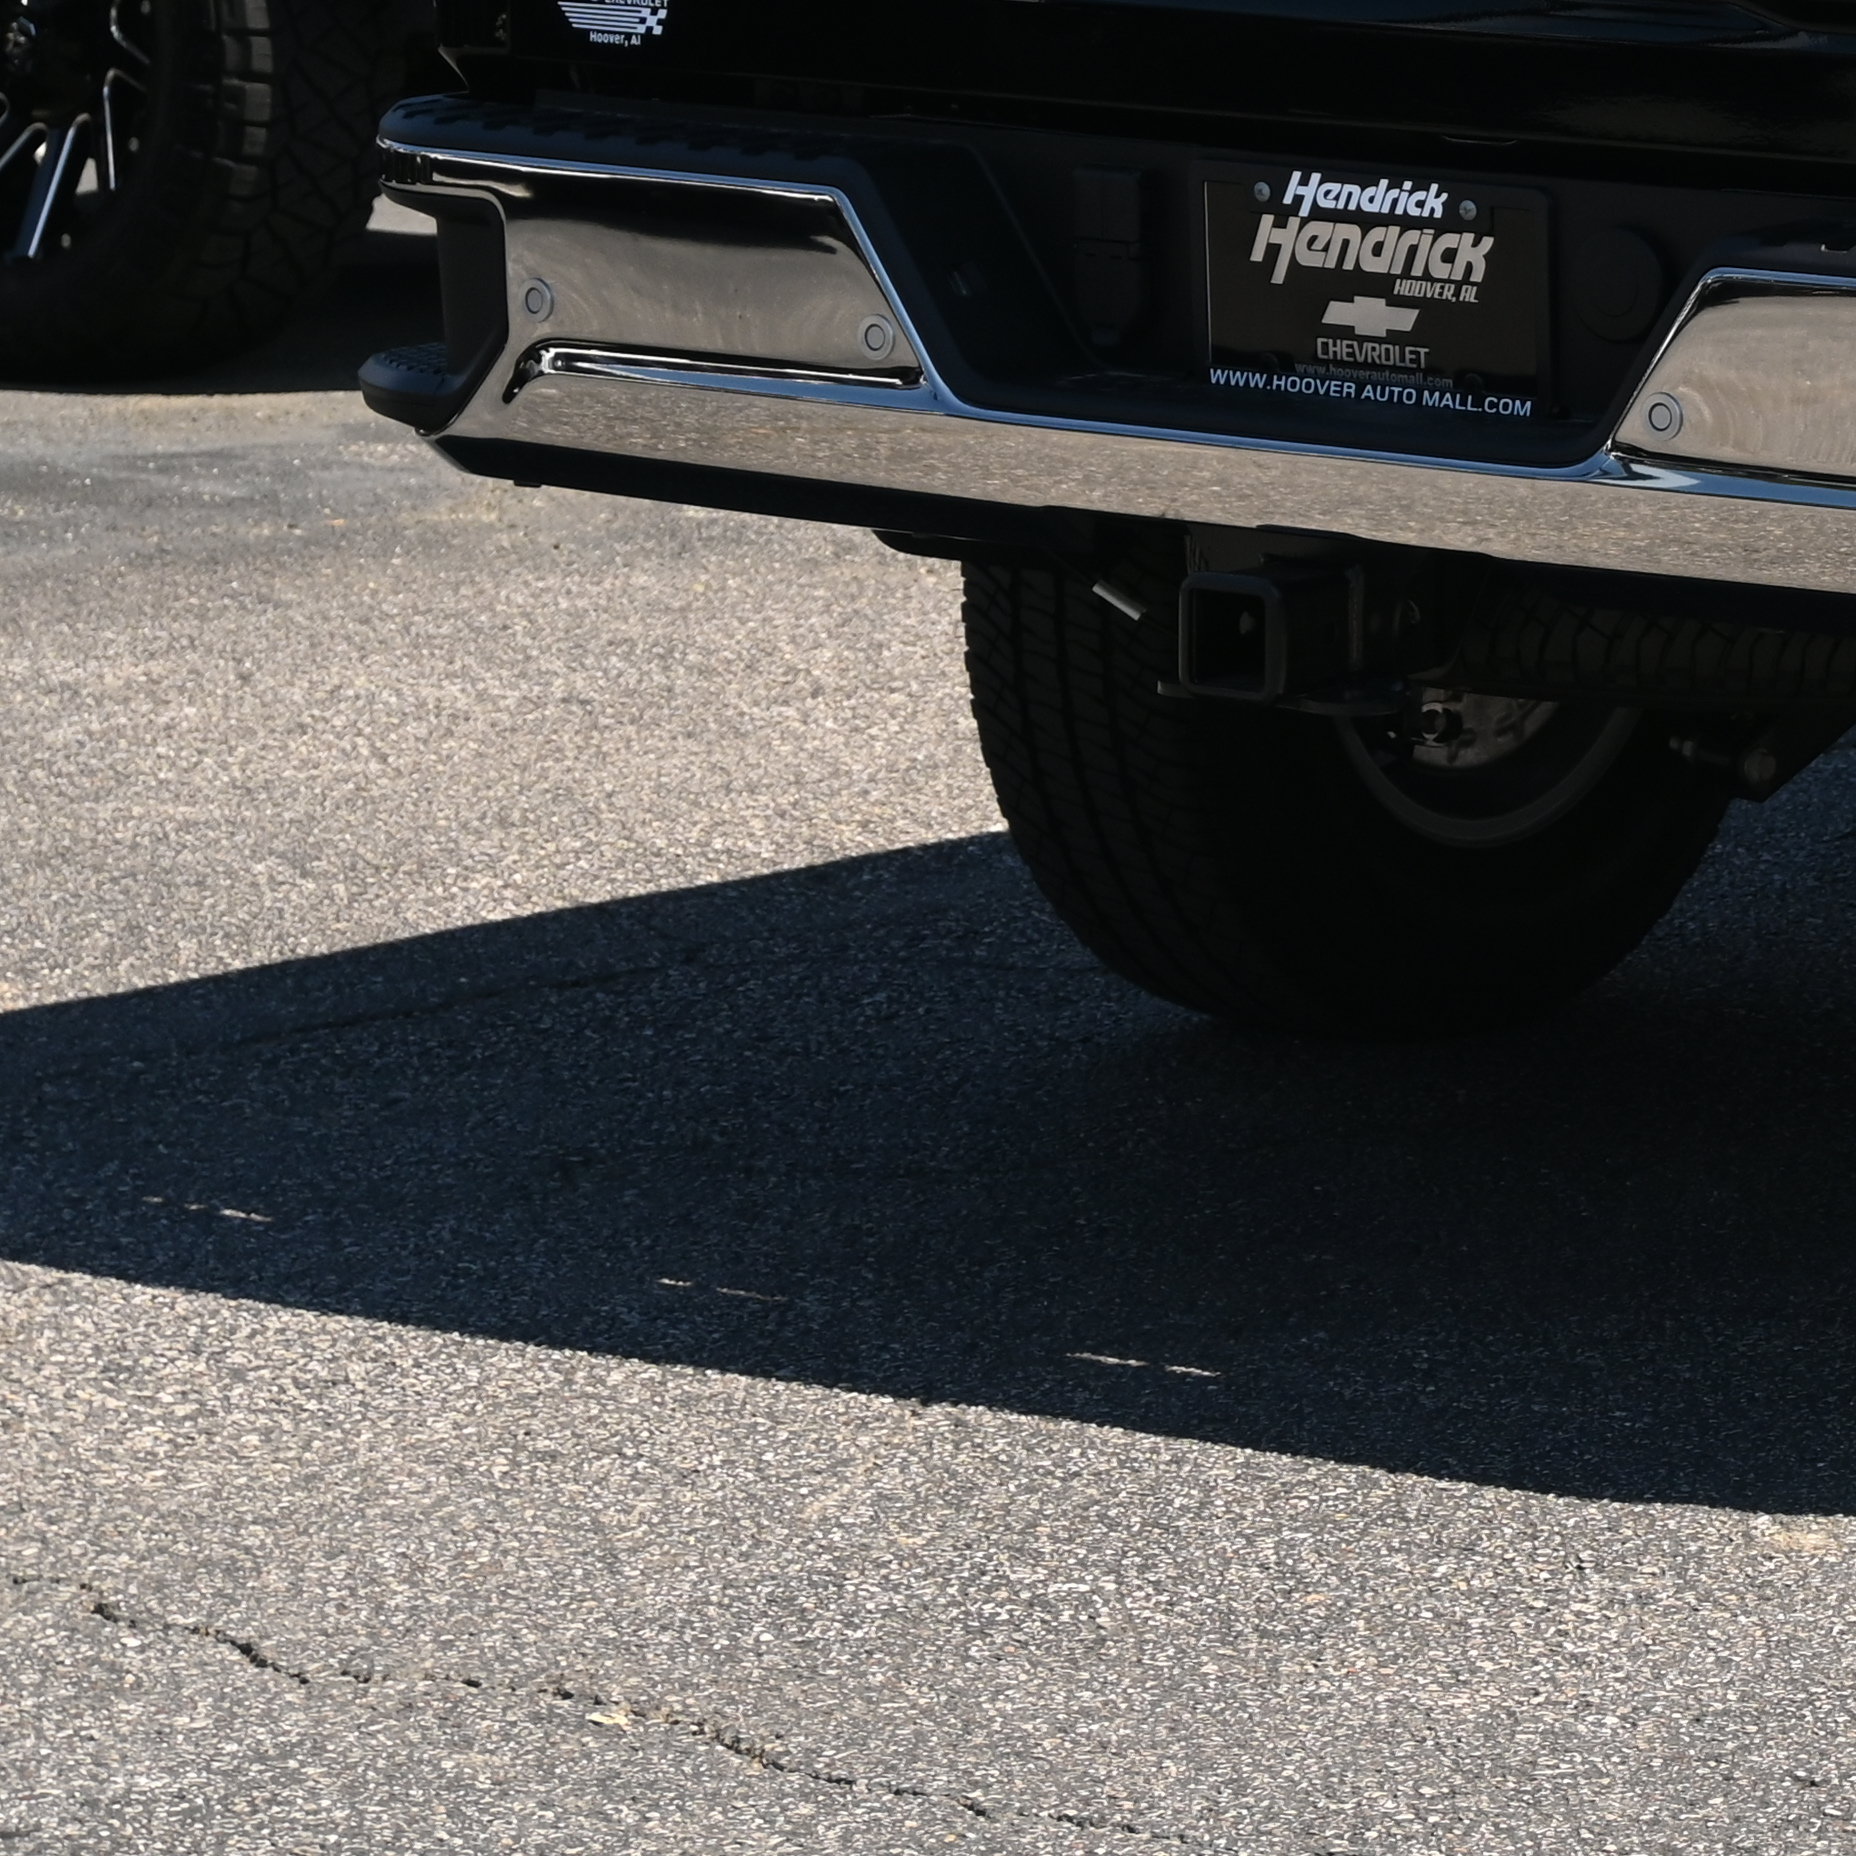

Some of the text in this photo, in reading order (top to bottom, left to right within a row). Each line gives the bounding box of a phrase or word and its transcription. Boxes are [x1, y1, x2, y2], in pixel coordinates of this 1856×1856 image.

[589, 30, 629, 48] Hoover,
[1282, 170, 1449, 218] Hendrick
[1249, 213, 1494, 285] Hendrick
[1393, 278, 1480, 303] HOOVER, AL
[1316, 337, 1430, 369] CHEVROLET
[1295, 361, 1454, 390] www.hooverautomall.com
[1210, 367, 1532, 417] WWW.HOOVER AUTO MALL.COM
